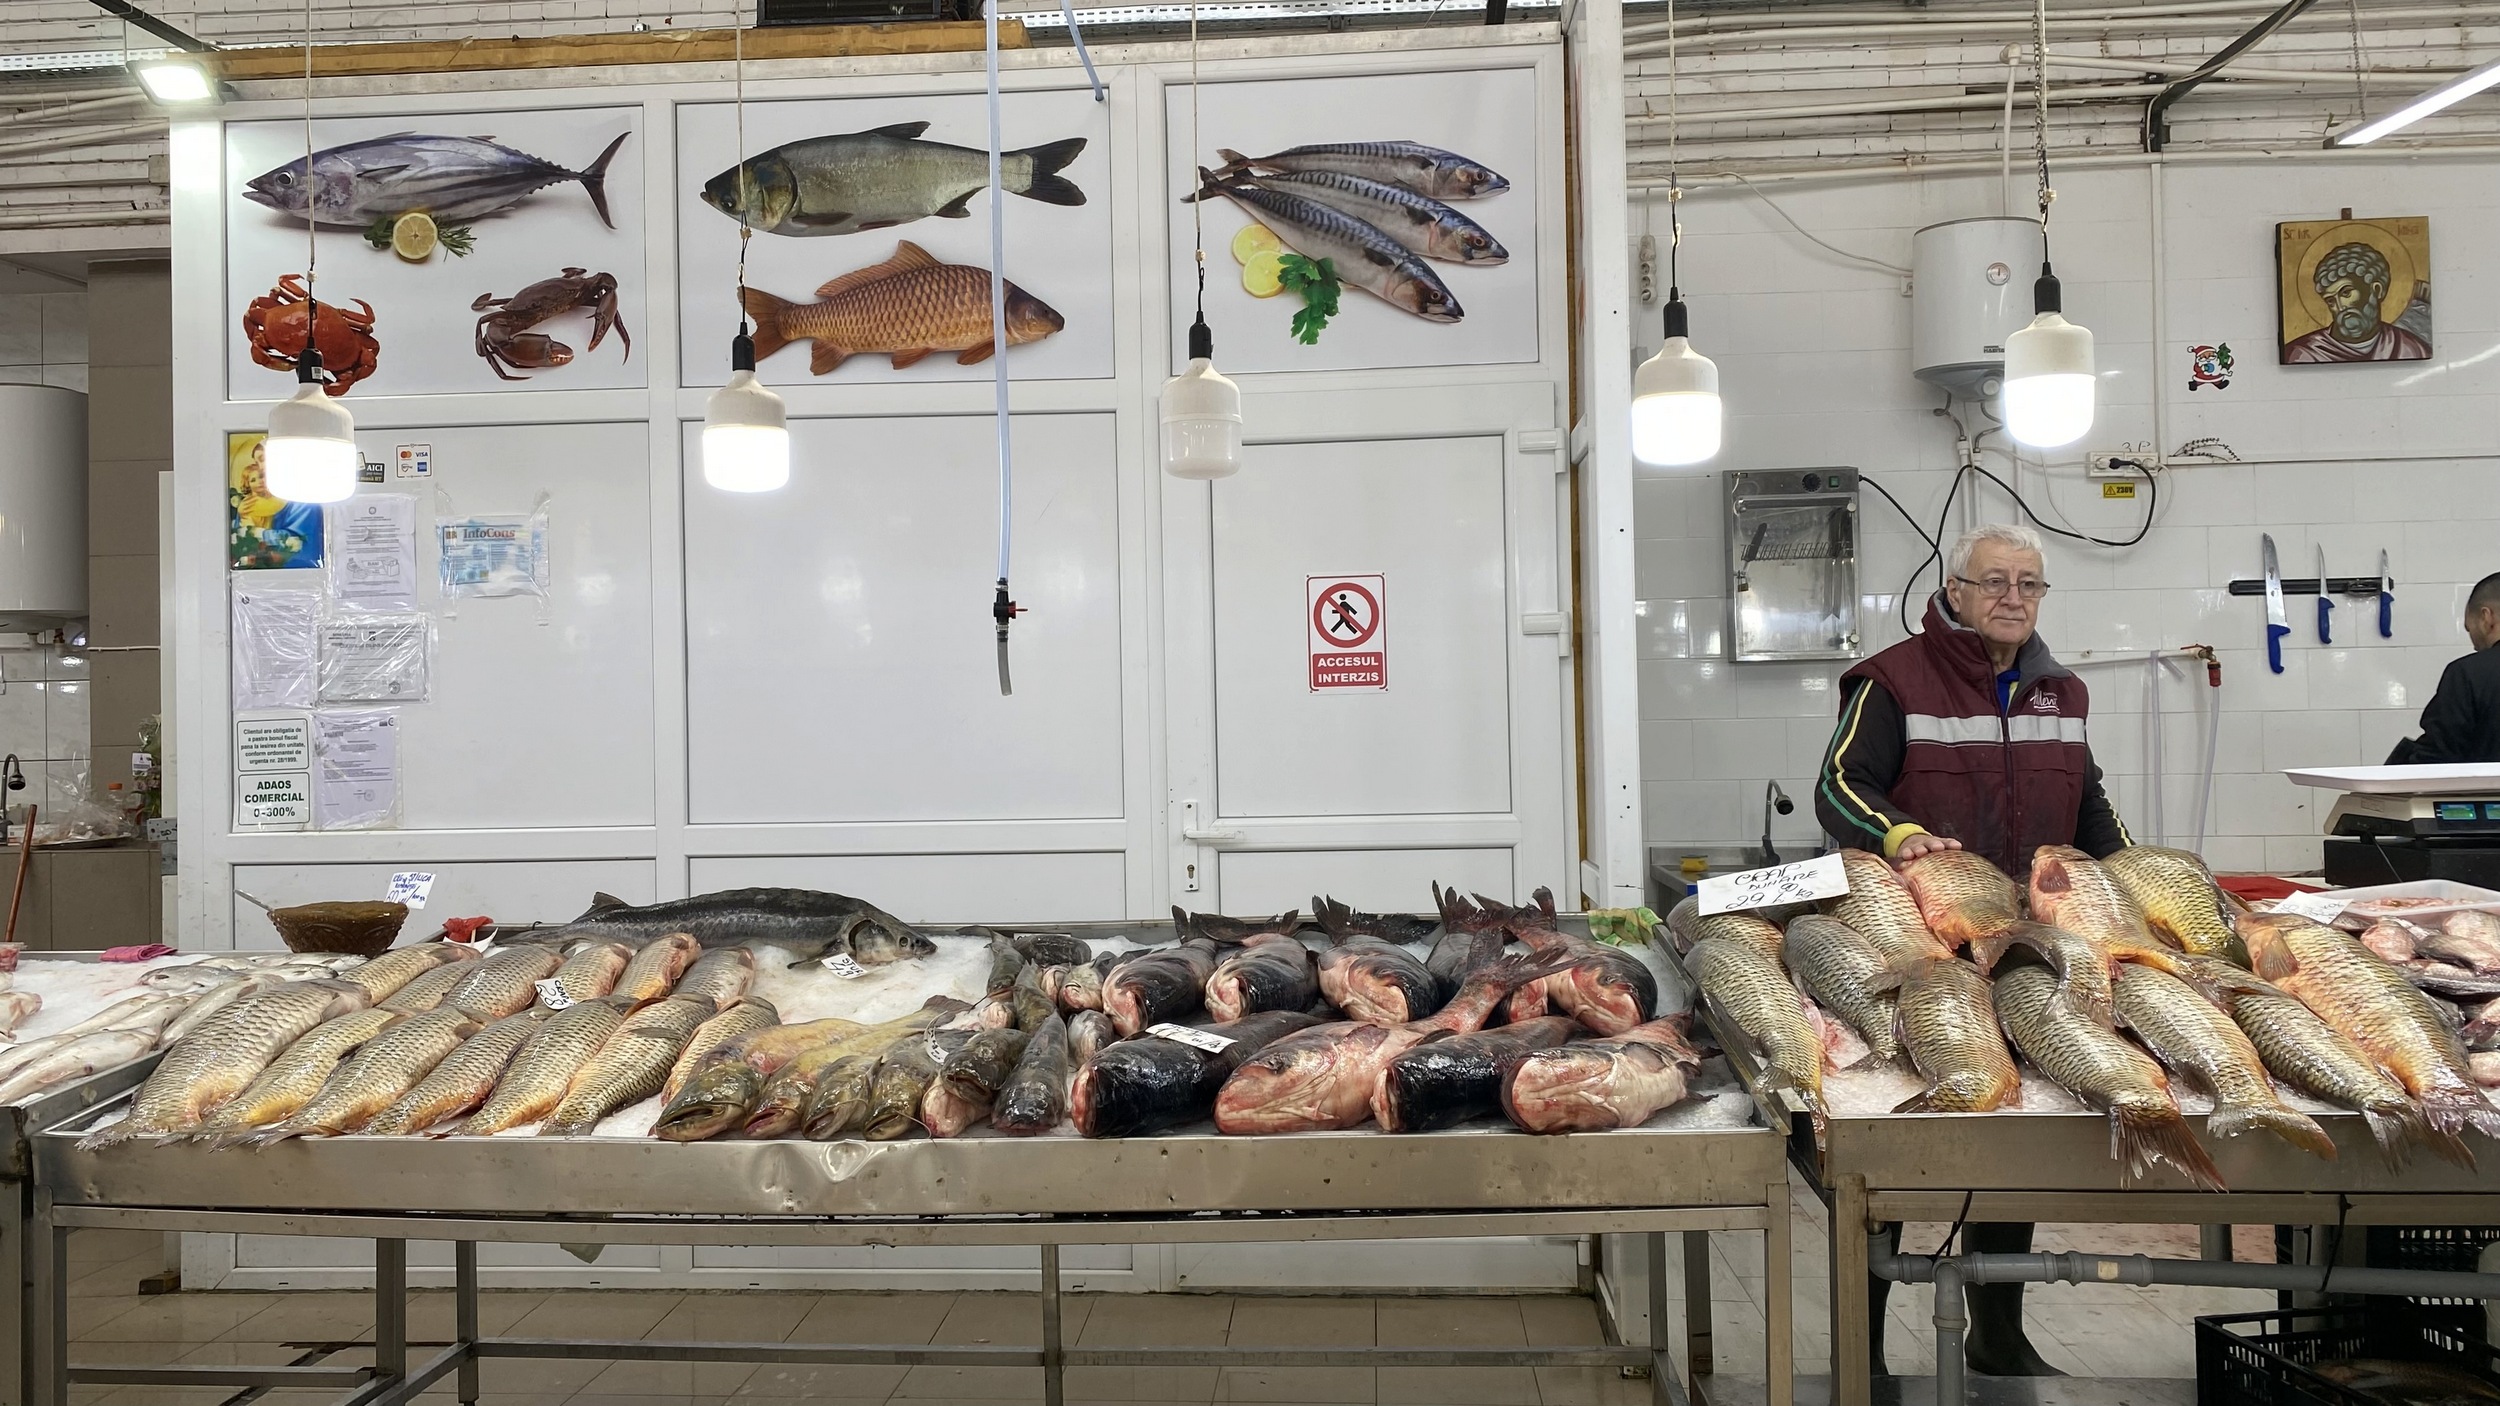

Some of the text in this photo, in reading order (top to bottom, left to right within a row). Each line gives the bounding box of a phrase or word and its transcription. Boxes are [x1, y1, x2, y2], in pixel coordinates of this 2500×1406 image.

[366, 464, 383, 472] AICI
[2116, 486, 2134, 494] 230V
[463, 528, 516, 539] InfoCons
[1317, 656, 1379, 667] ACCESUL
[1318, 672, 1380, 683] INTERZIS
[257, 780, 292, 790] ADAOS
[244, 792, 305, 803] COMERCIAL
[1734, 863, 1802, 886] CRAP
[1725, 891, 1765, 910] 29
